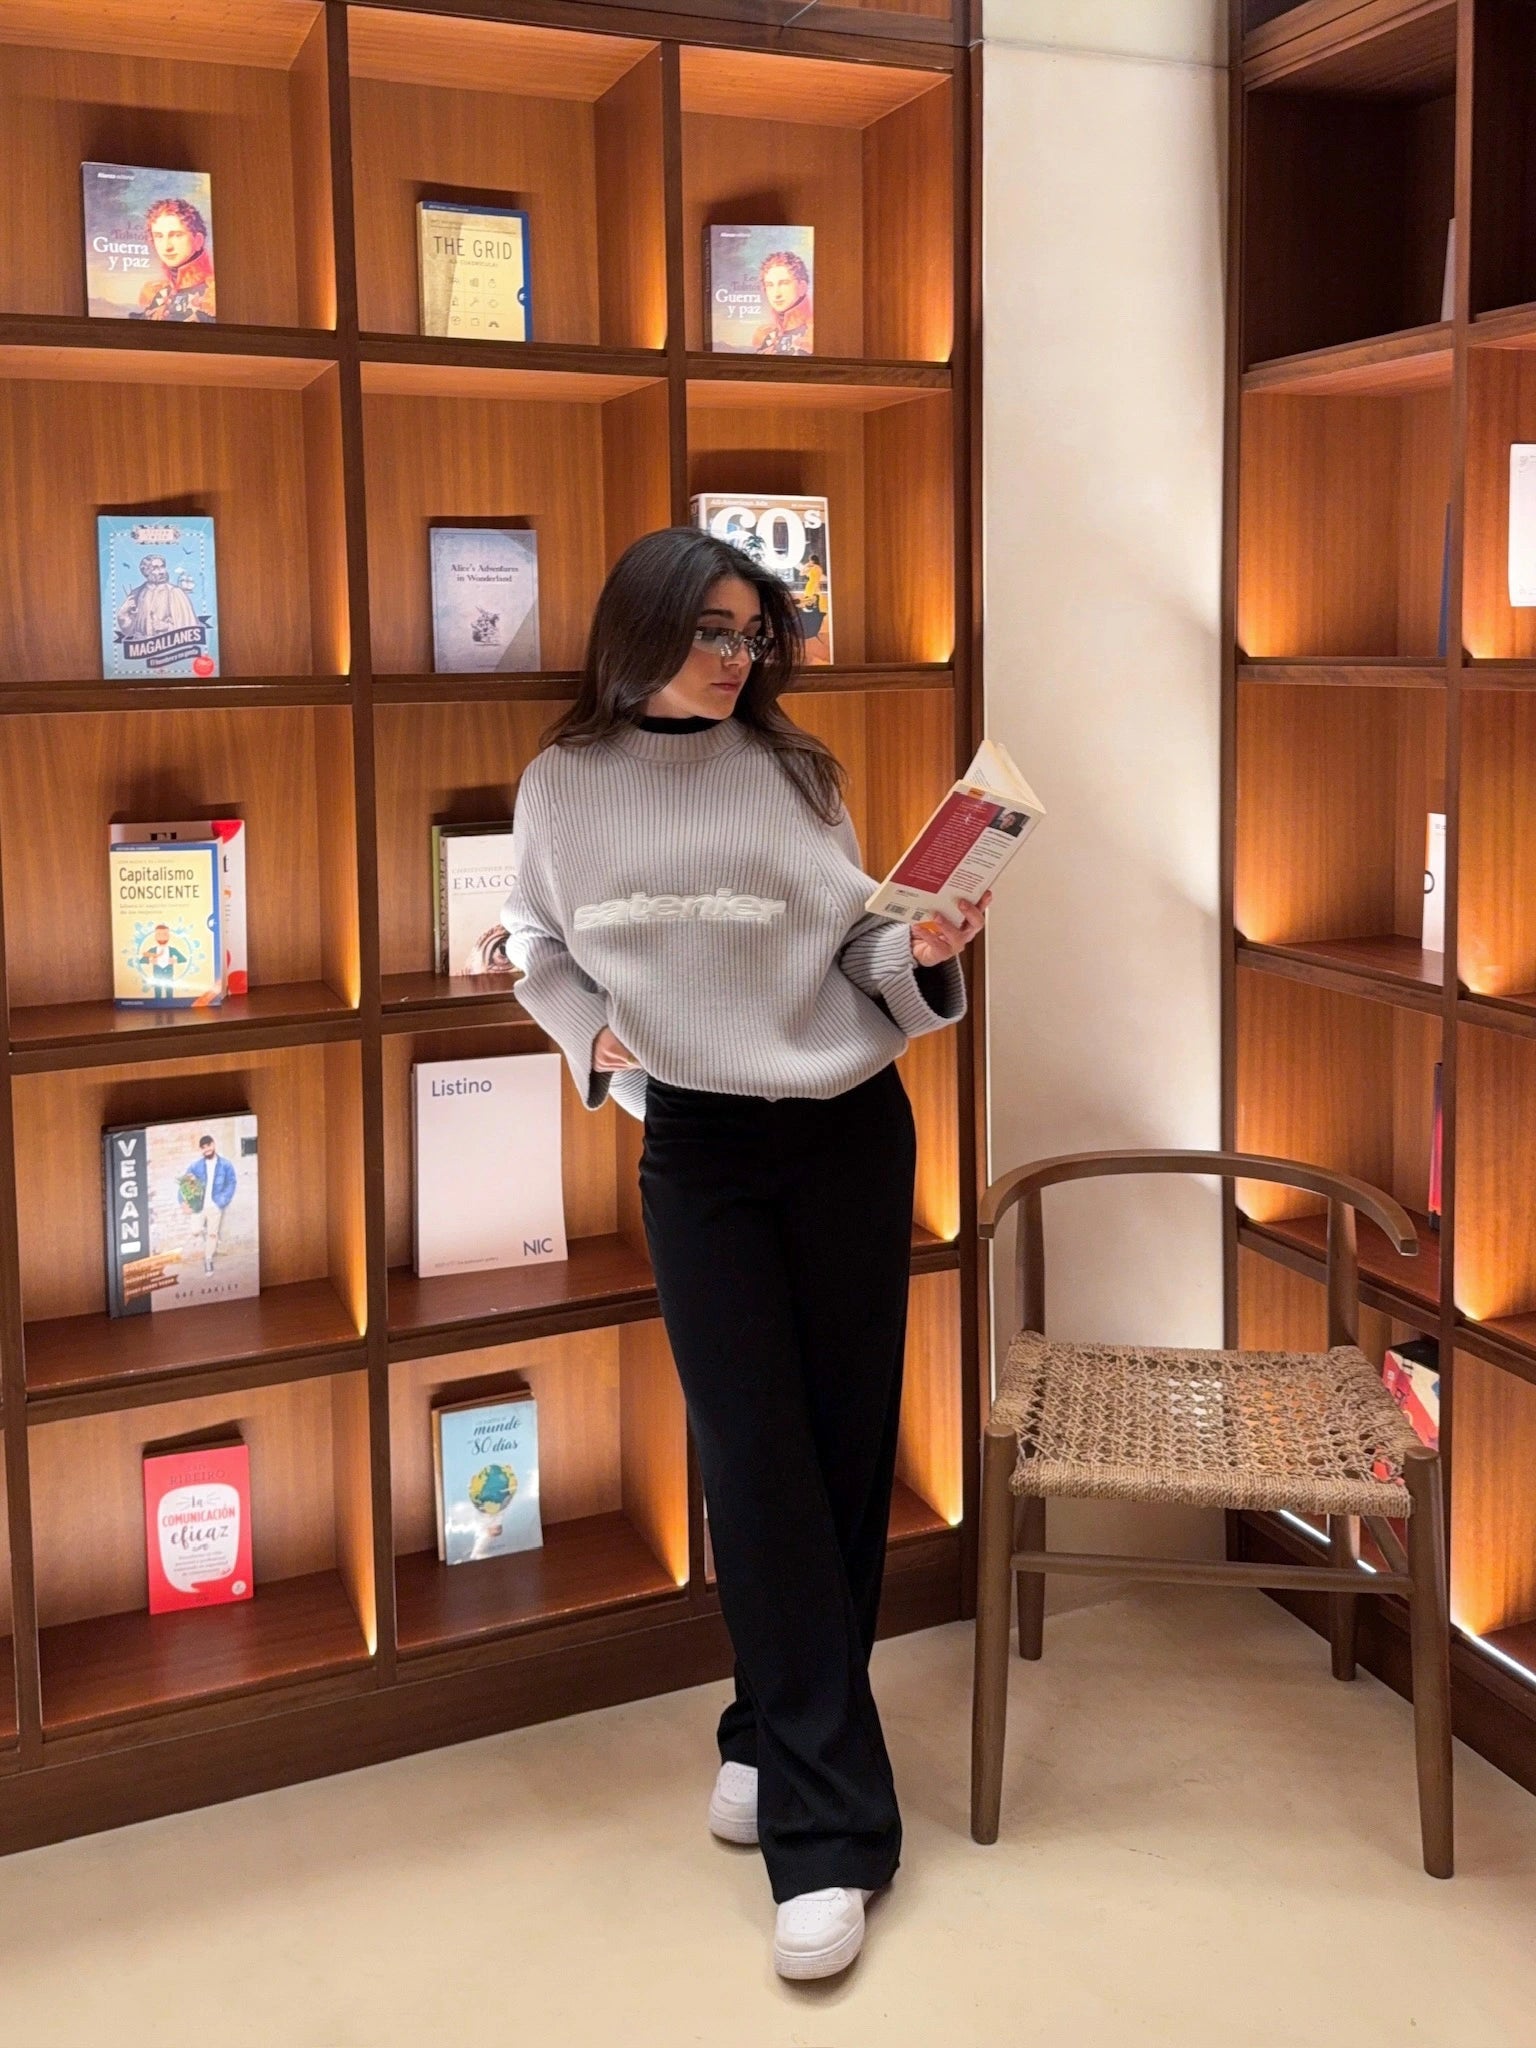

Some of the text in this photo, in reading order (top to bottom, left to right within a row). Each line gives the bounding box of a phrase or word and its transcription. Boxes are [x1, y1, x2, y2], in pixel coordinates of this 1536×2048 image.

[93, 235, 150, 255] Guerra
[433, 235, 512, 260] THE GRID
[108, 255, 150, 271] y paz
[715, 288, 761, 304] Guerra
[728, 305, 761, 319] y paz
[451, 562, 519, 573] Alice's Adventures
[456, 573, 512, 583] in Wonderland
[129, 628, 202, 657] MAGALLANES
[119, 867, 194, 884] Capitalismo
[453, 874, 517, 890] ERAGO
[120, 884, 200, 900] CONSCIENTE
[432, 1077, 492, 1097] Listino
[117, 1138, 140, 1241] VEGAN
[523, 1237, 554, 1256] NIC
[473, 1415, 522, 1436] mundo
[192, 1495, 204, 1508] la
[162, 1503, 236, 1527] COMUNICACIÓN
[170, 1525, 229, 1550] eficaz
